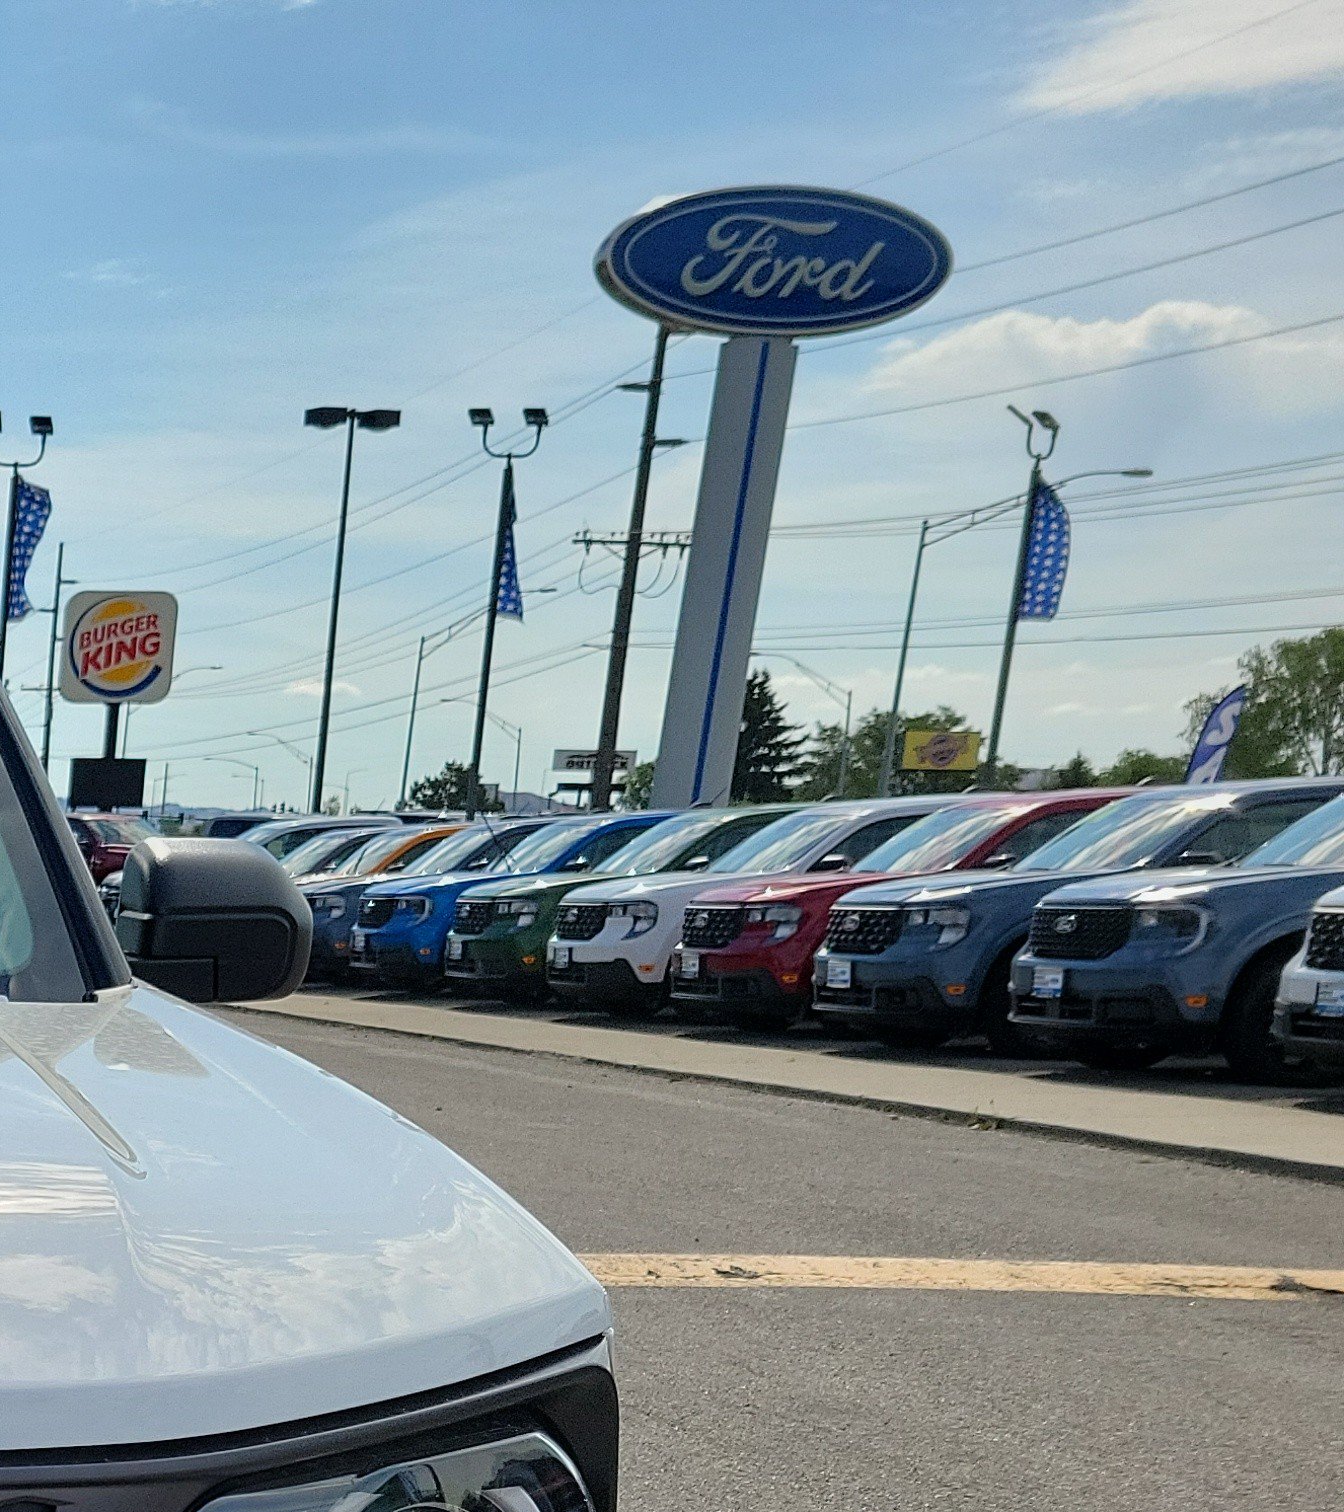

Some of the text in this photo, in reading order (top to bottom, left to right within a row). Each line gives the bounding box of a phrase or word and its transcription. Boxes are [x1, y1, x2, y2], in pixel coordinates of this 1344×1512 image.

[680, 213, 886, 301] Ford
[79, 613, 159, 650] BURGER
[80, 632, 161, 676] KING
